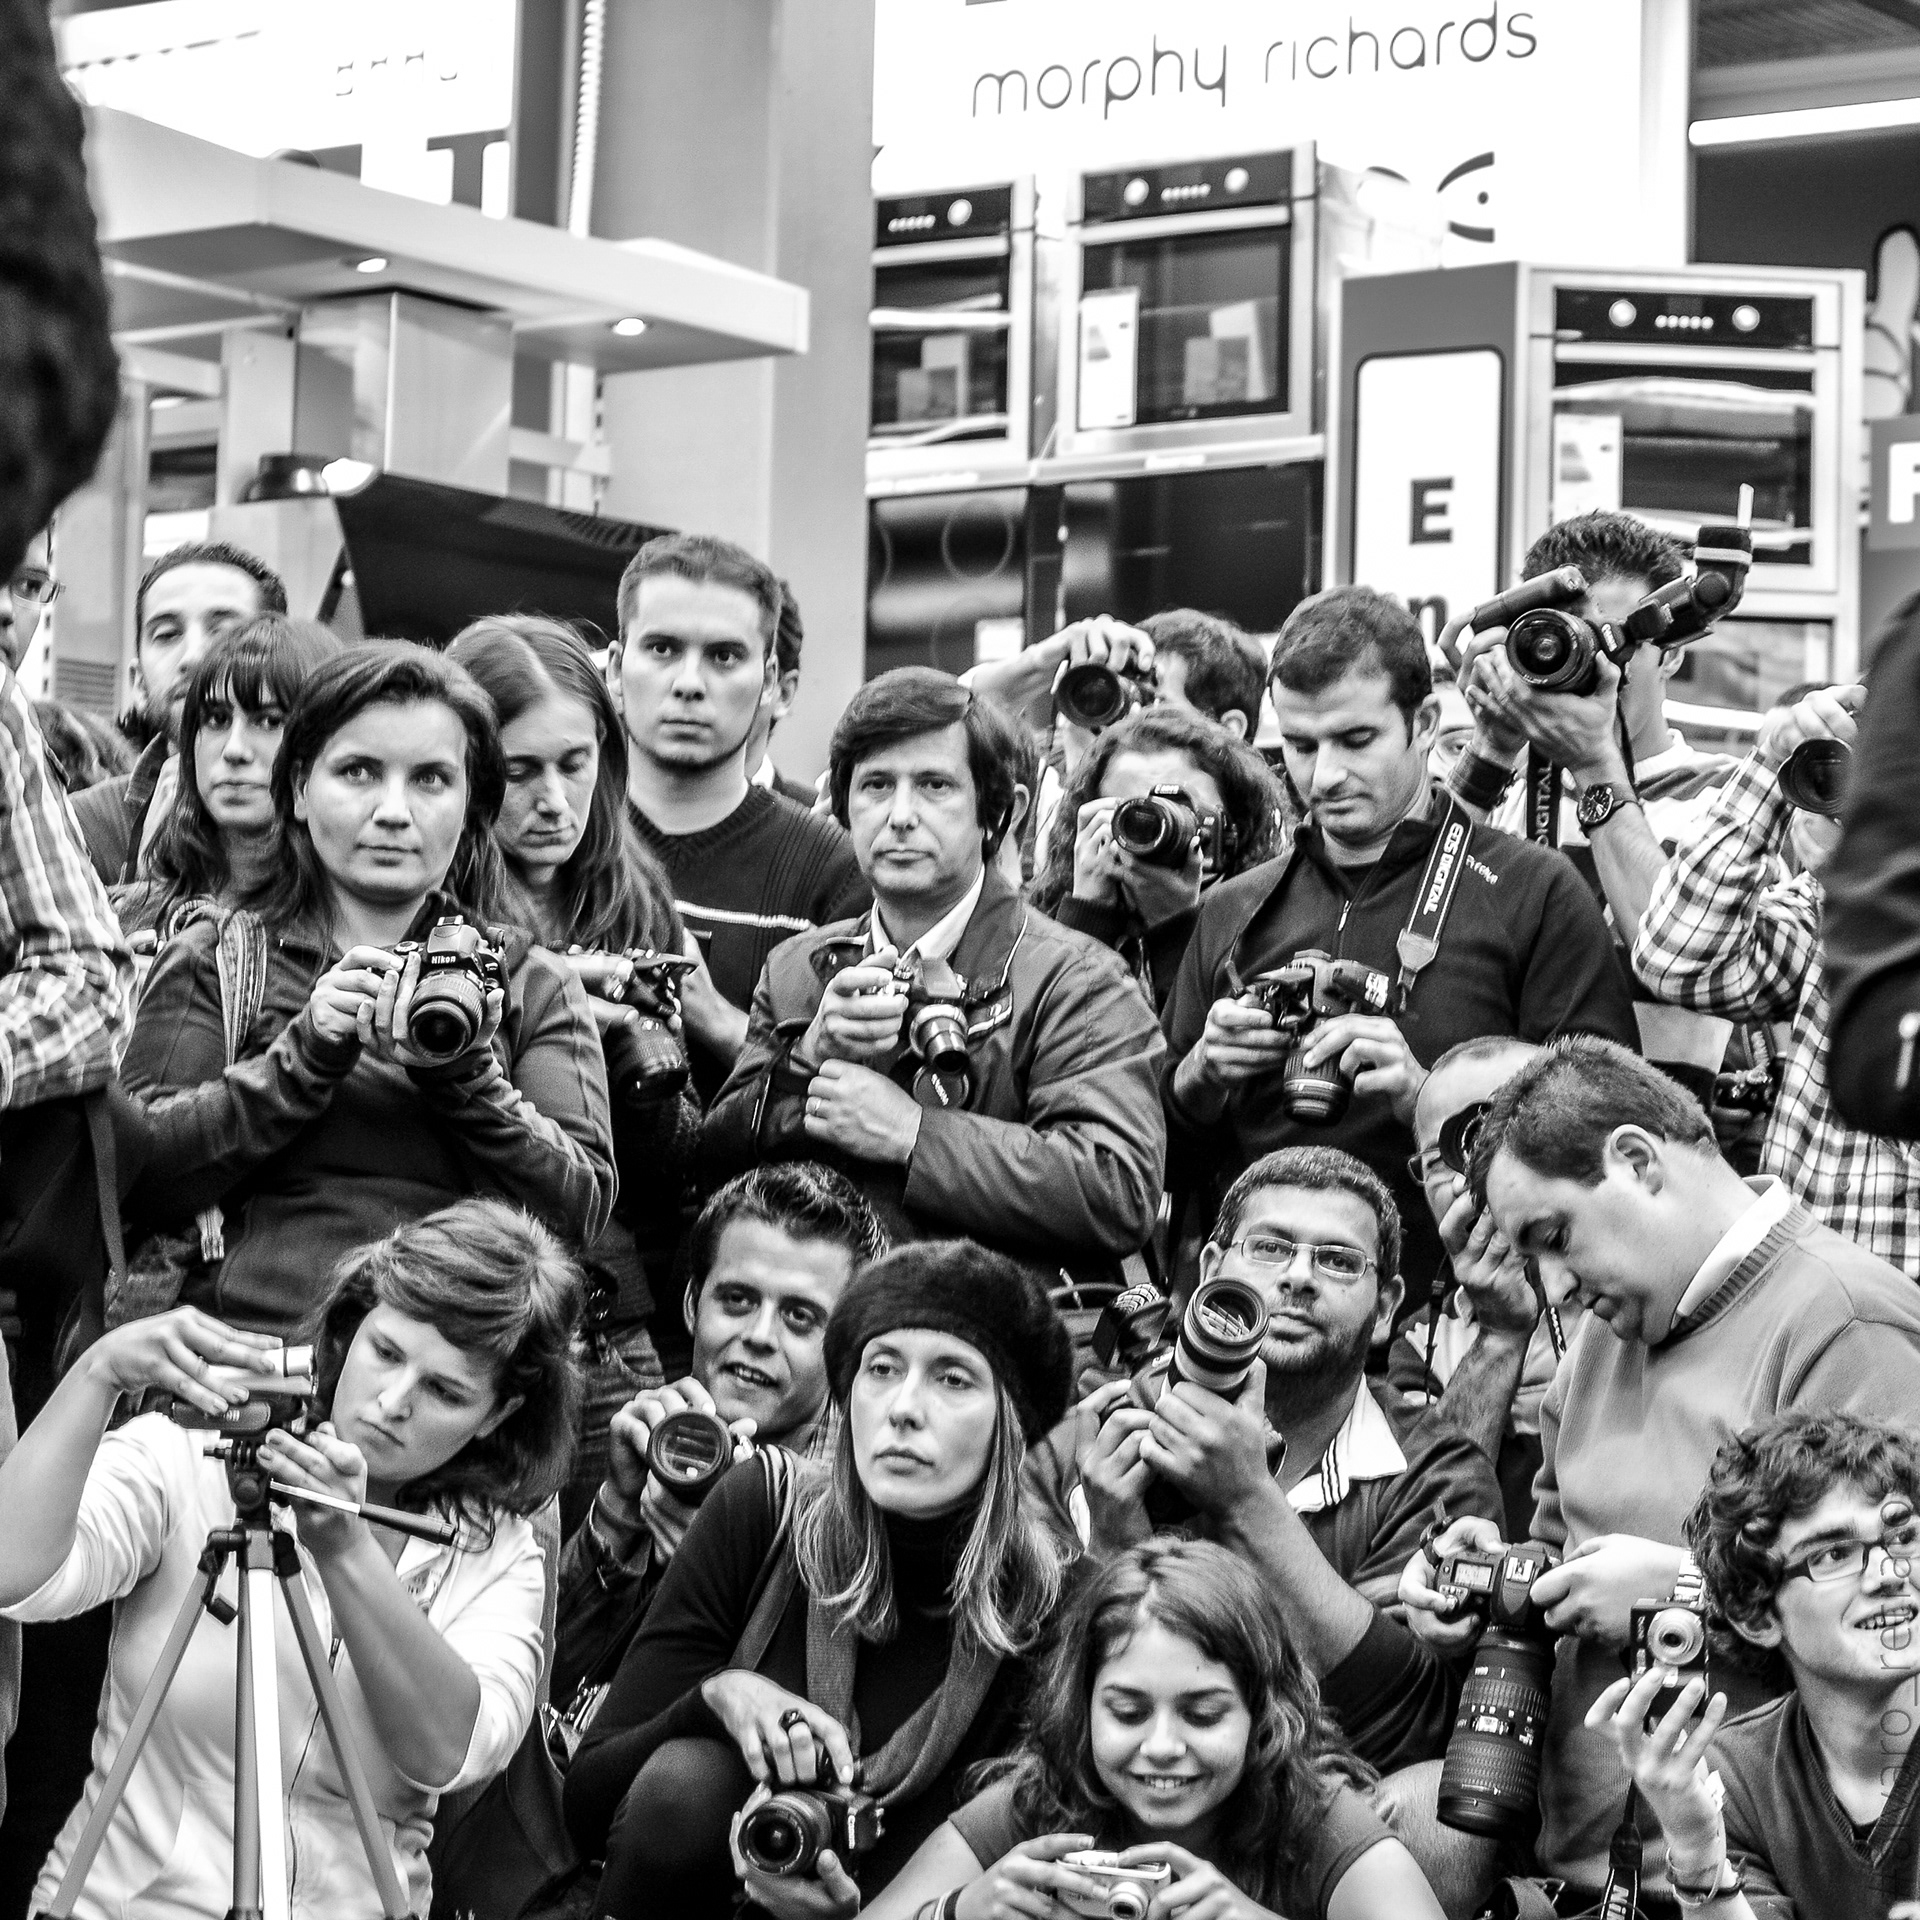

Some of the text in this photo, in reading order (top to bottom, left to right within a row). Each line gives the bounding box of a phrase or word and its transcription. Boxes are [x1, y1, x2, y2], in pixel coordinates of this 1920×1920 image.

[972, 0, 1537, 120] morphy richards
[1422, 822, 1464, 916] EOS DIGITAL
[431, 955, 457, 965] Nikon
